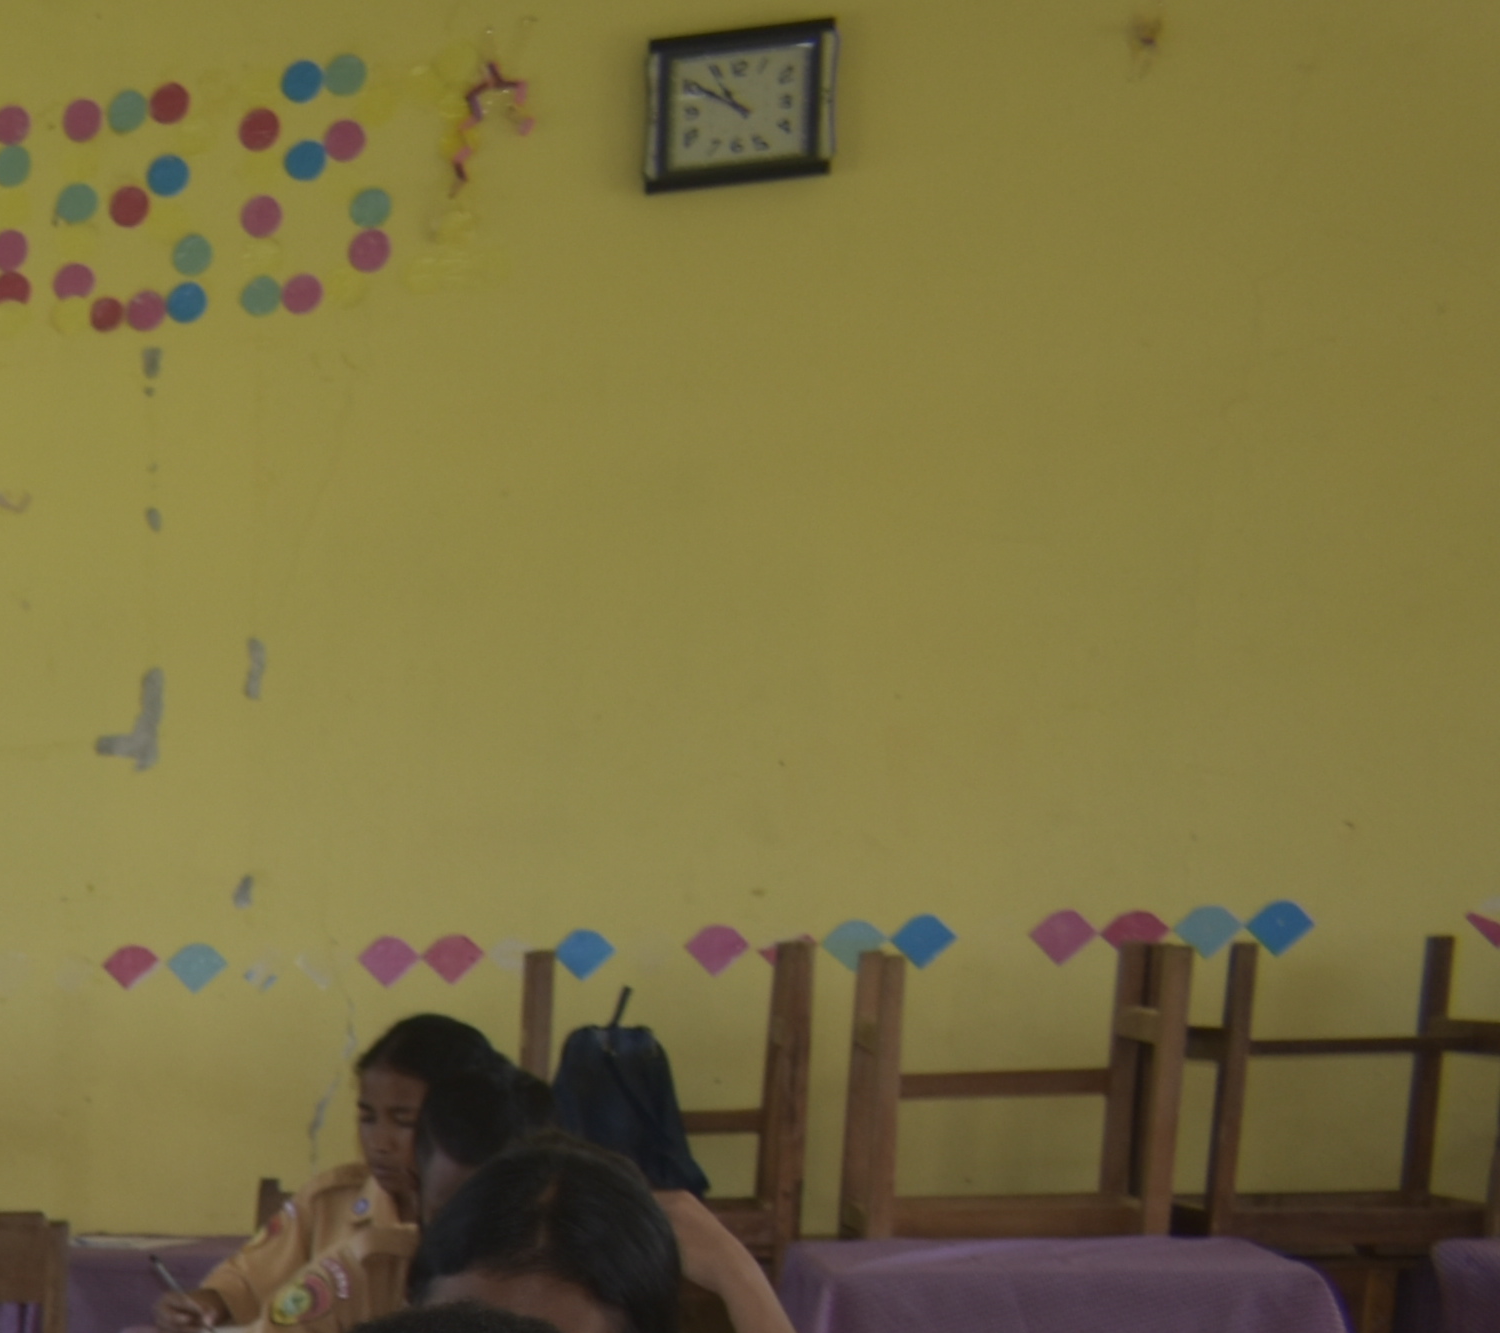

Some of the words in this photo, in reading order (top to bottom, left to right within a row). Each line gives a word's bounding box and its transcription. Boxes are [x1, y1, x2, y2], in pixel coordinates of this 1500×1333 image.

[730, 58, 748, 78] 12
[730, 136, 745, 154] 6
[751, 133, 770, 152] 5
